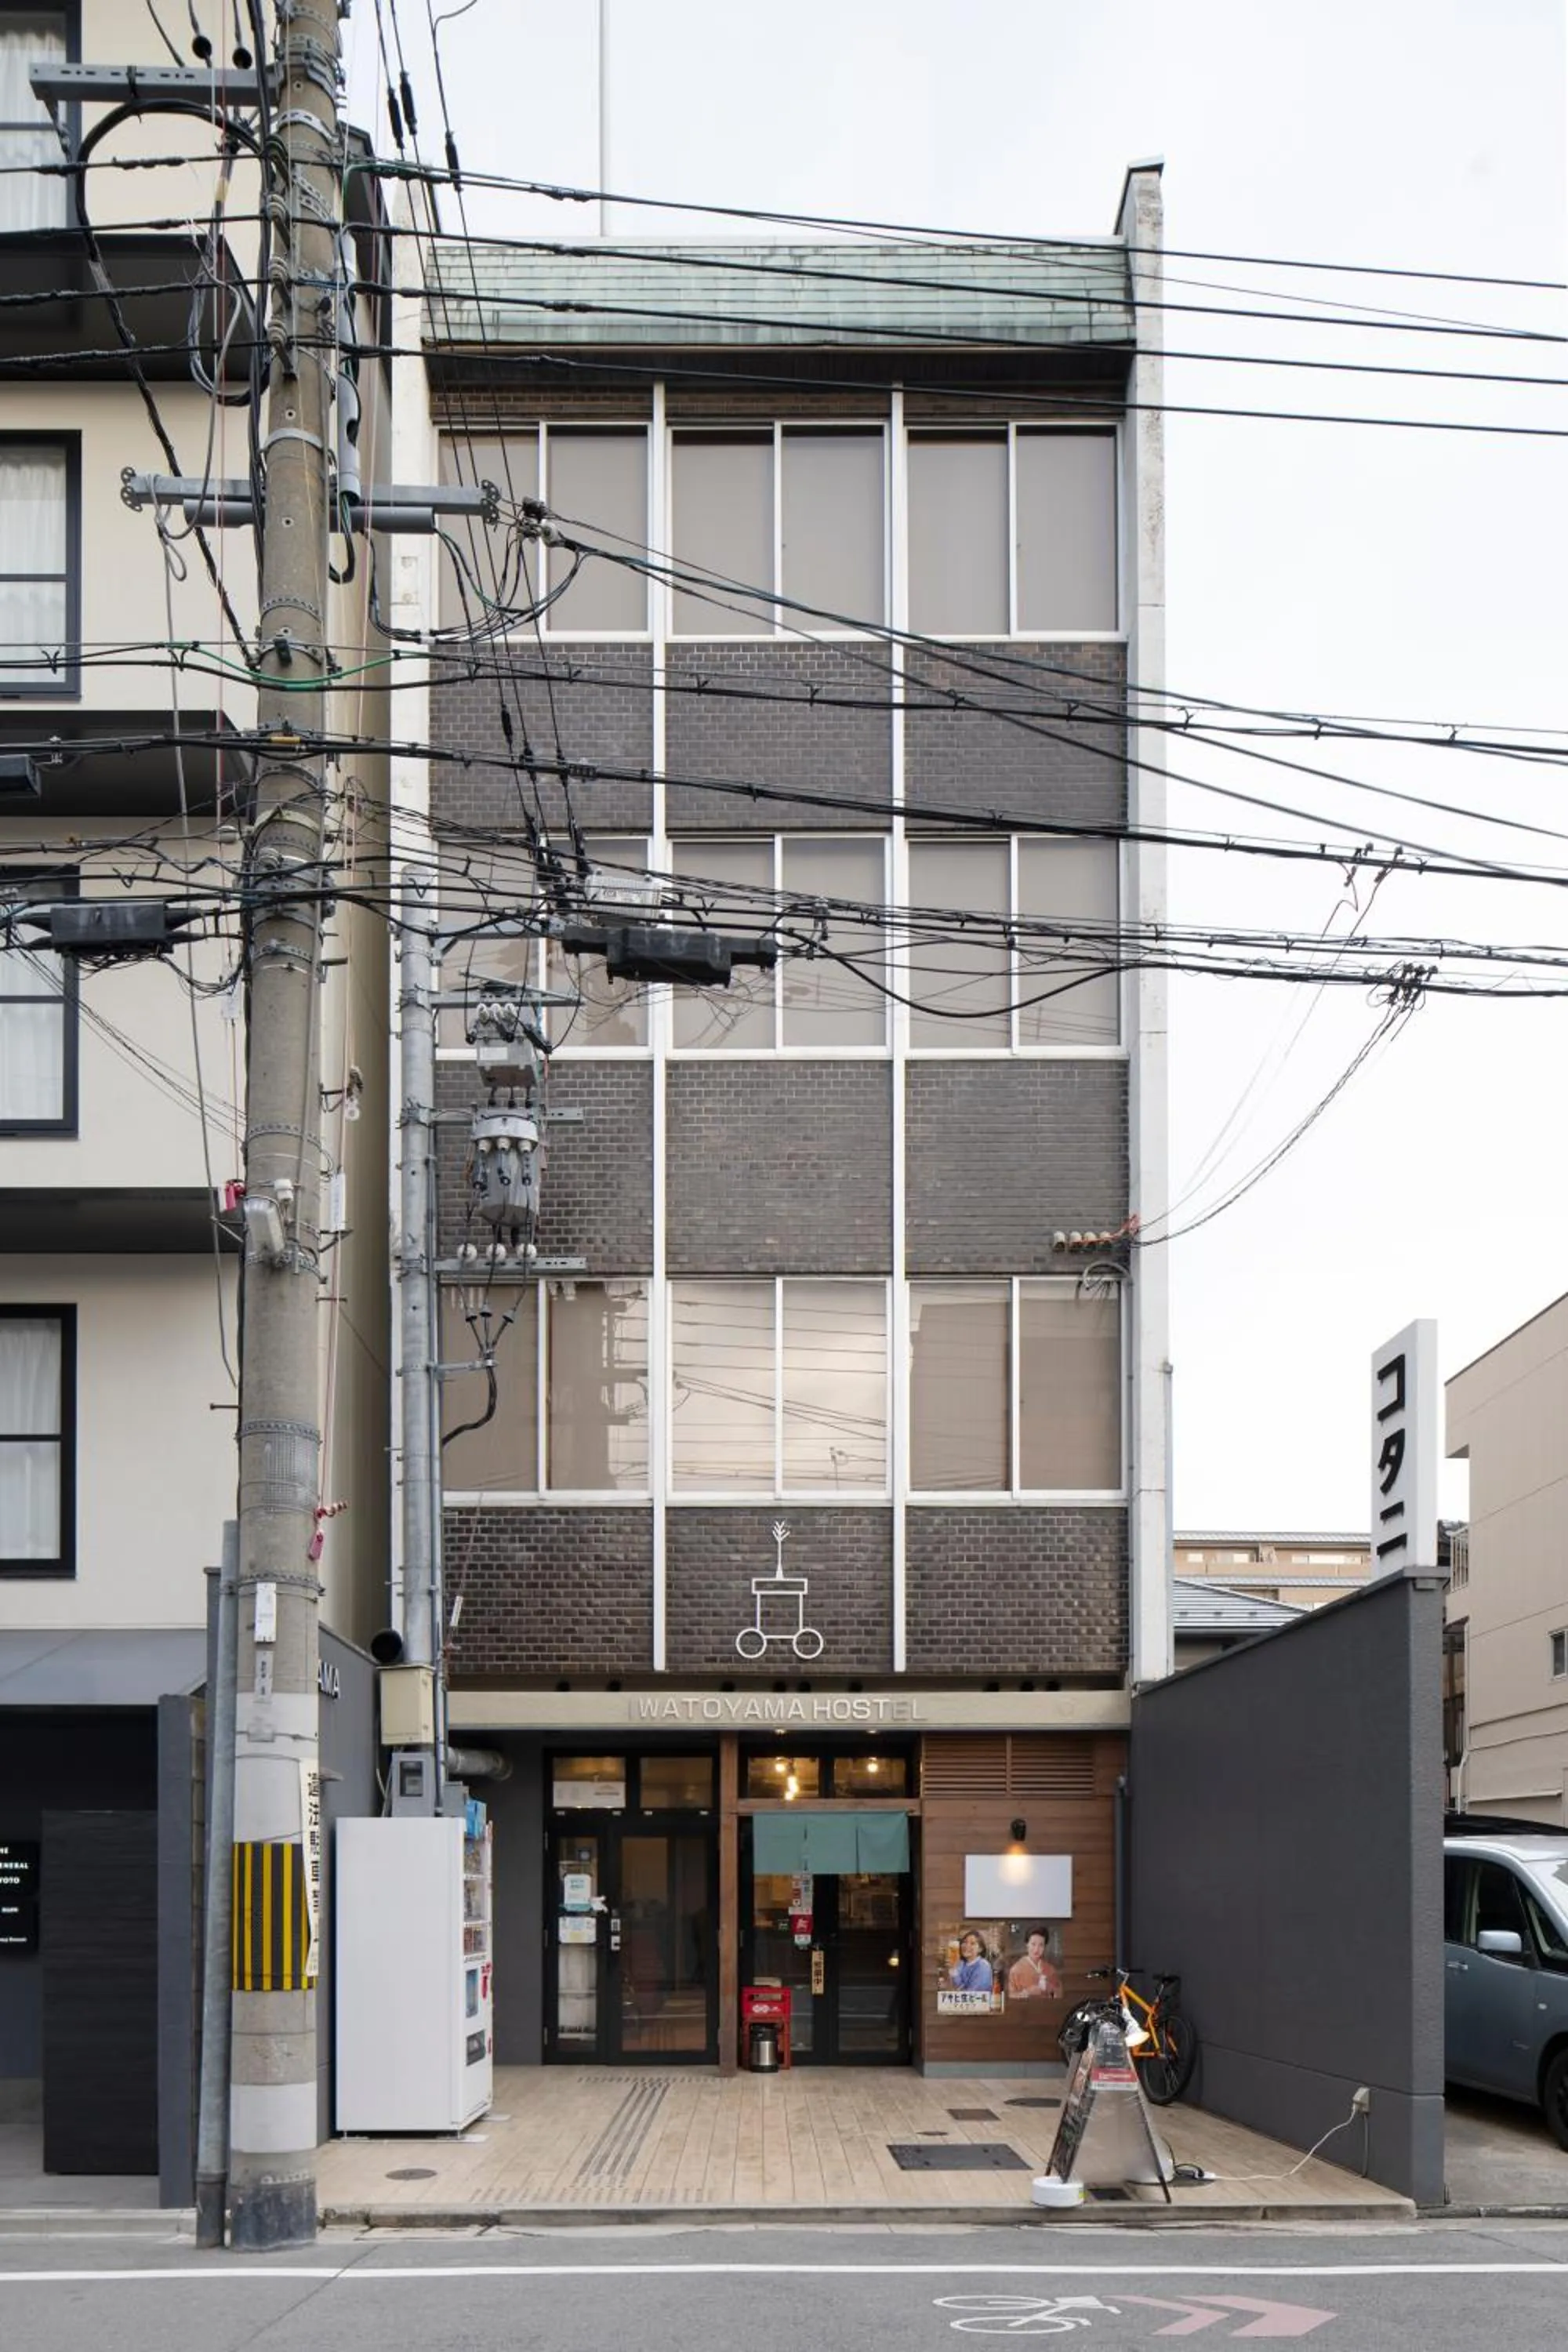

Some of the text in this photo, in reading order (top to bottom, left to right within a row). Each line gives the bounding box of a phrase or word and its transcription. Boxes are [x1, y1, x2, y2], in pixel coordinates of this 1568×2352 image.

[1377, 1353, 1407, 1557] コタニ
[813, 1698, 927, 1721] HOSTEL
